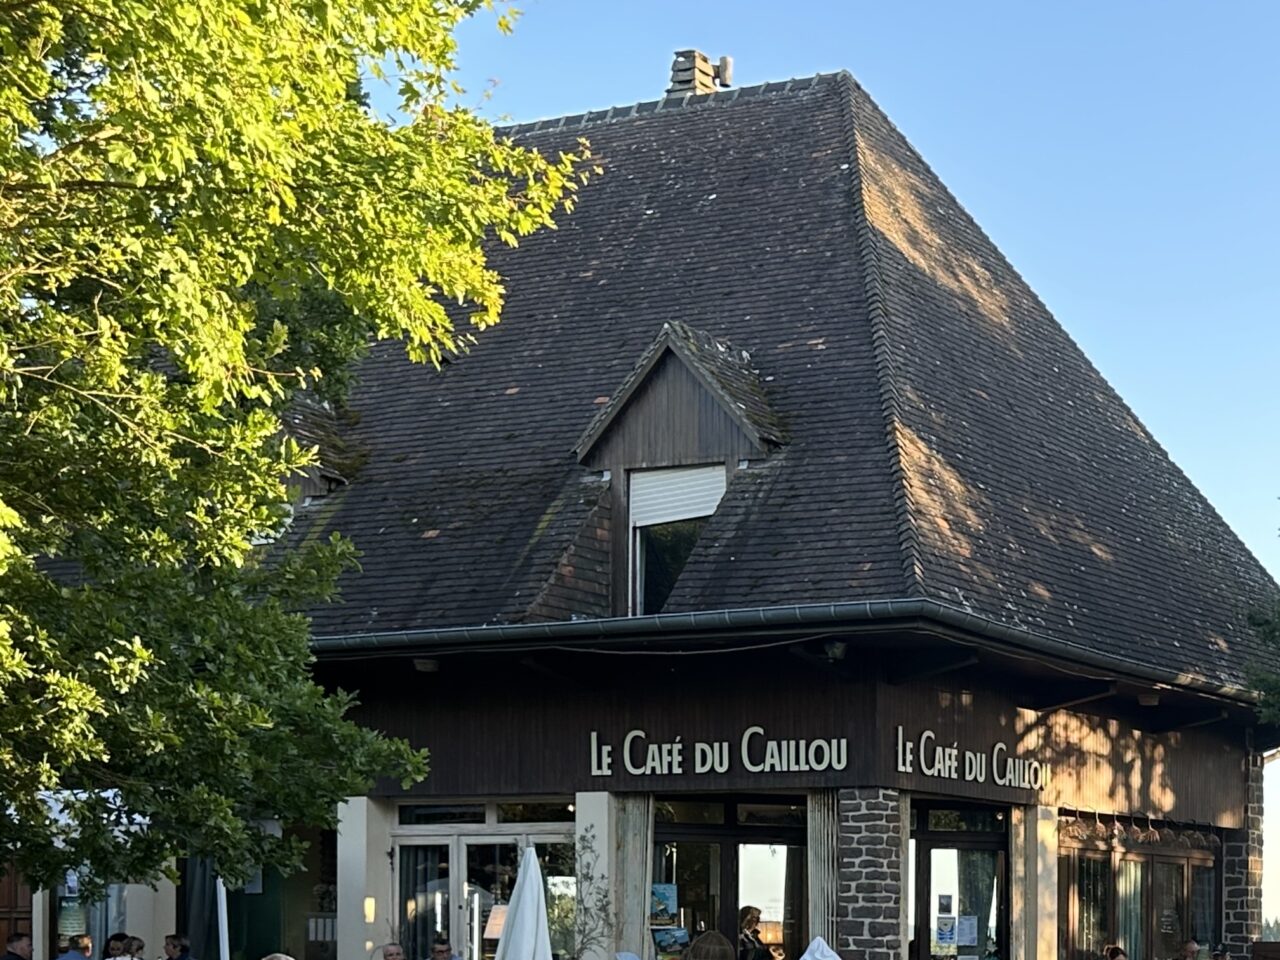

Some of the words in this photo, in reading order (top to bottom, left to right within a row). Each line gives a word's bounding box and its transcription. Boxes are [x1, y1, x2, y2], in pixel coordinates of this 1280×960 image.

[590, 731, 612, 776] LE
[623, 729, 683, 776] CAFÉ
[694, 741, 729, 774] DU
[741, 725, 848, 773] CAILLOU
[897, 725, 914, 773] LE
[919, 729, 959, 780] CAFÉ
[964, 750, 986, 783] DU
[992, 742, 1051, 791] CAILLOU
